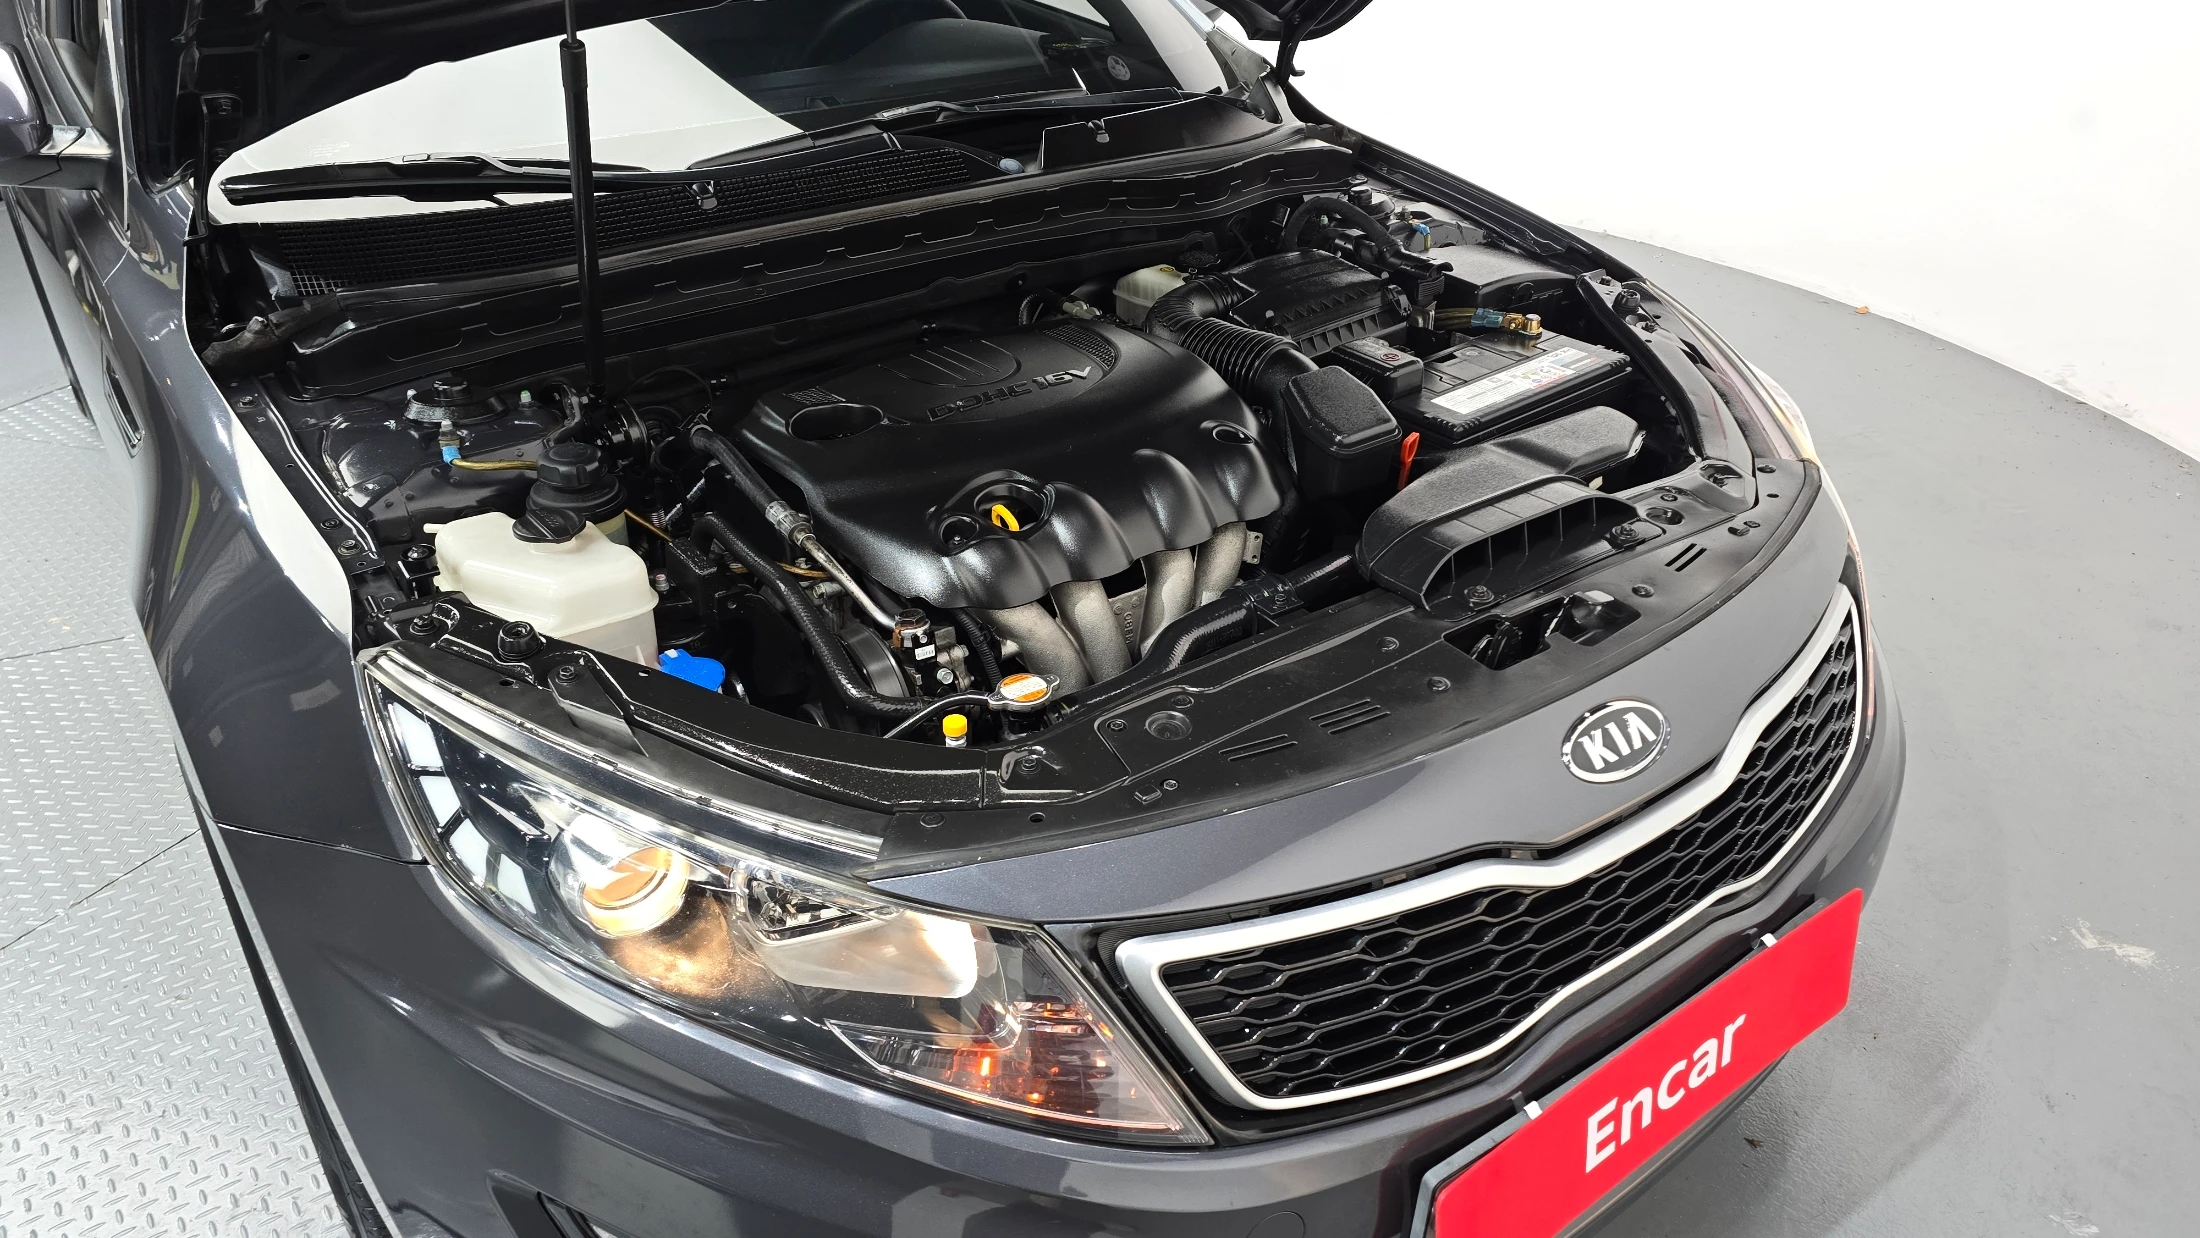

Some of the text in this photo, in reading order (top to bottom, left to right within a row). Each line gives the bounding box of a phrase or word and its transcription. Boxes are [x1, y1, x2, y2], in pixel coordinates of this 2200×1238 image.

[928, 365, 1092, 422] DOHC 16V
[1577, 711, 1658, 772] KIA
[1585, 1013, 1747, 1174] Encar
